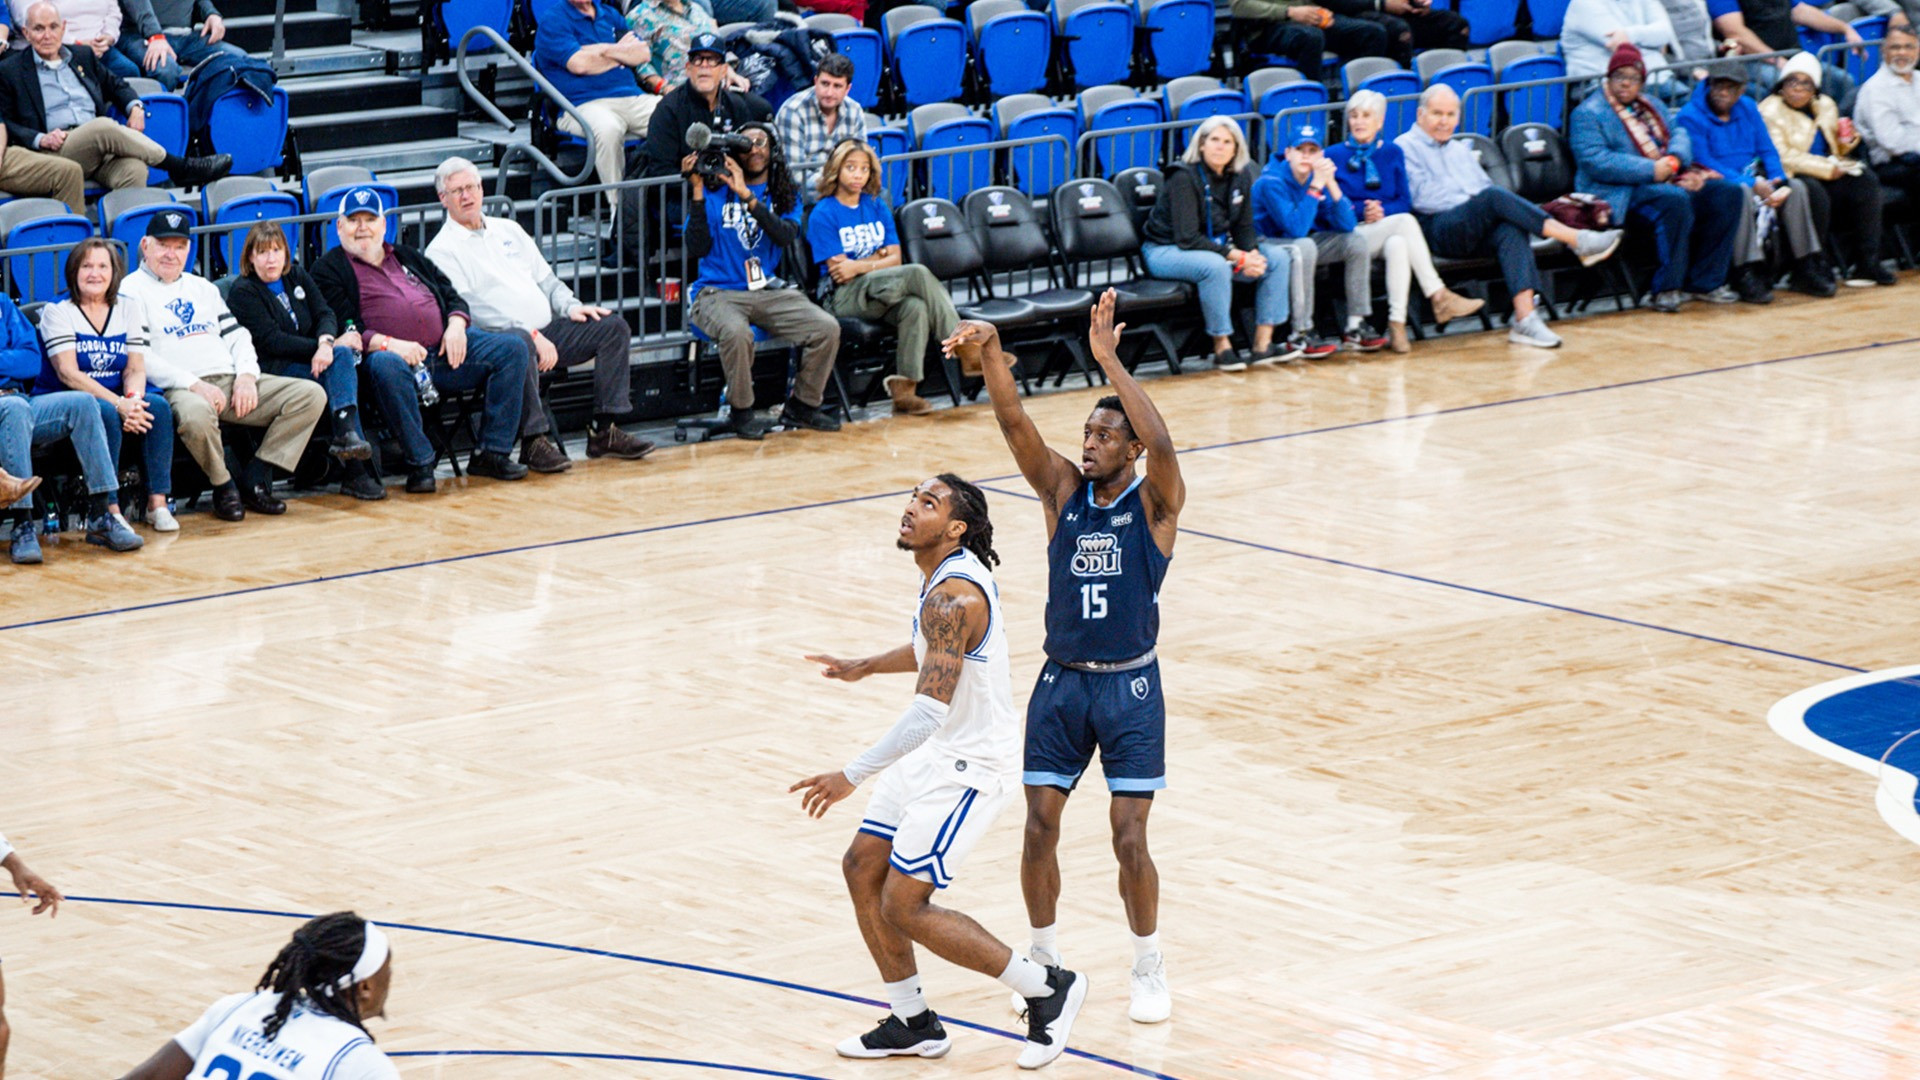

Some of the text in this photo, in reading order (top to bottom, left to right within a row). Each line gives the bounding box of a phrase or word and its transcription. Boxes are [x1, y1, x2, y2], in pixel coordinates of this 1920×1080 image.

[838, 220, 886, 249] GSU
[76, 340, 128, 355] EORGIA STA
[1071, 551, 1119, 575] ODU
[1080, 583, 1108, 619] 15
